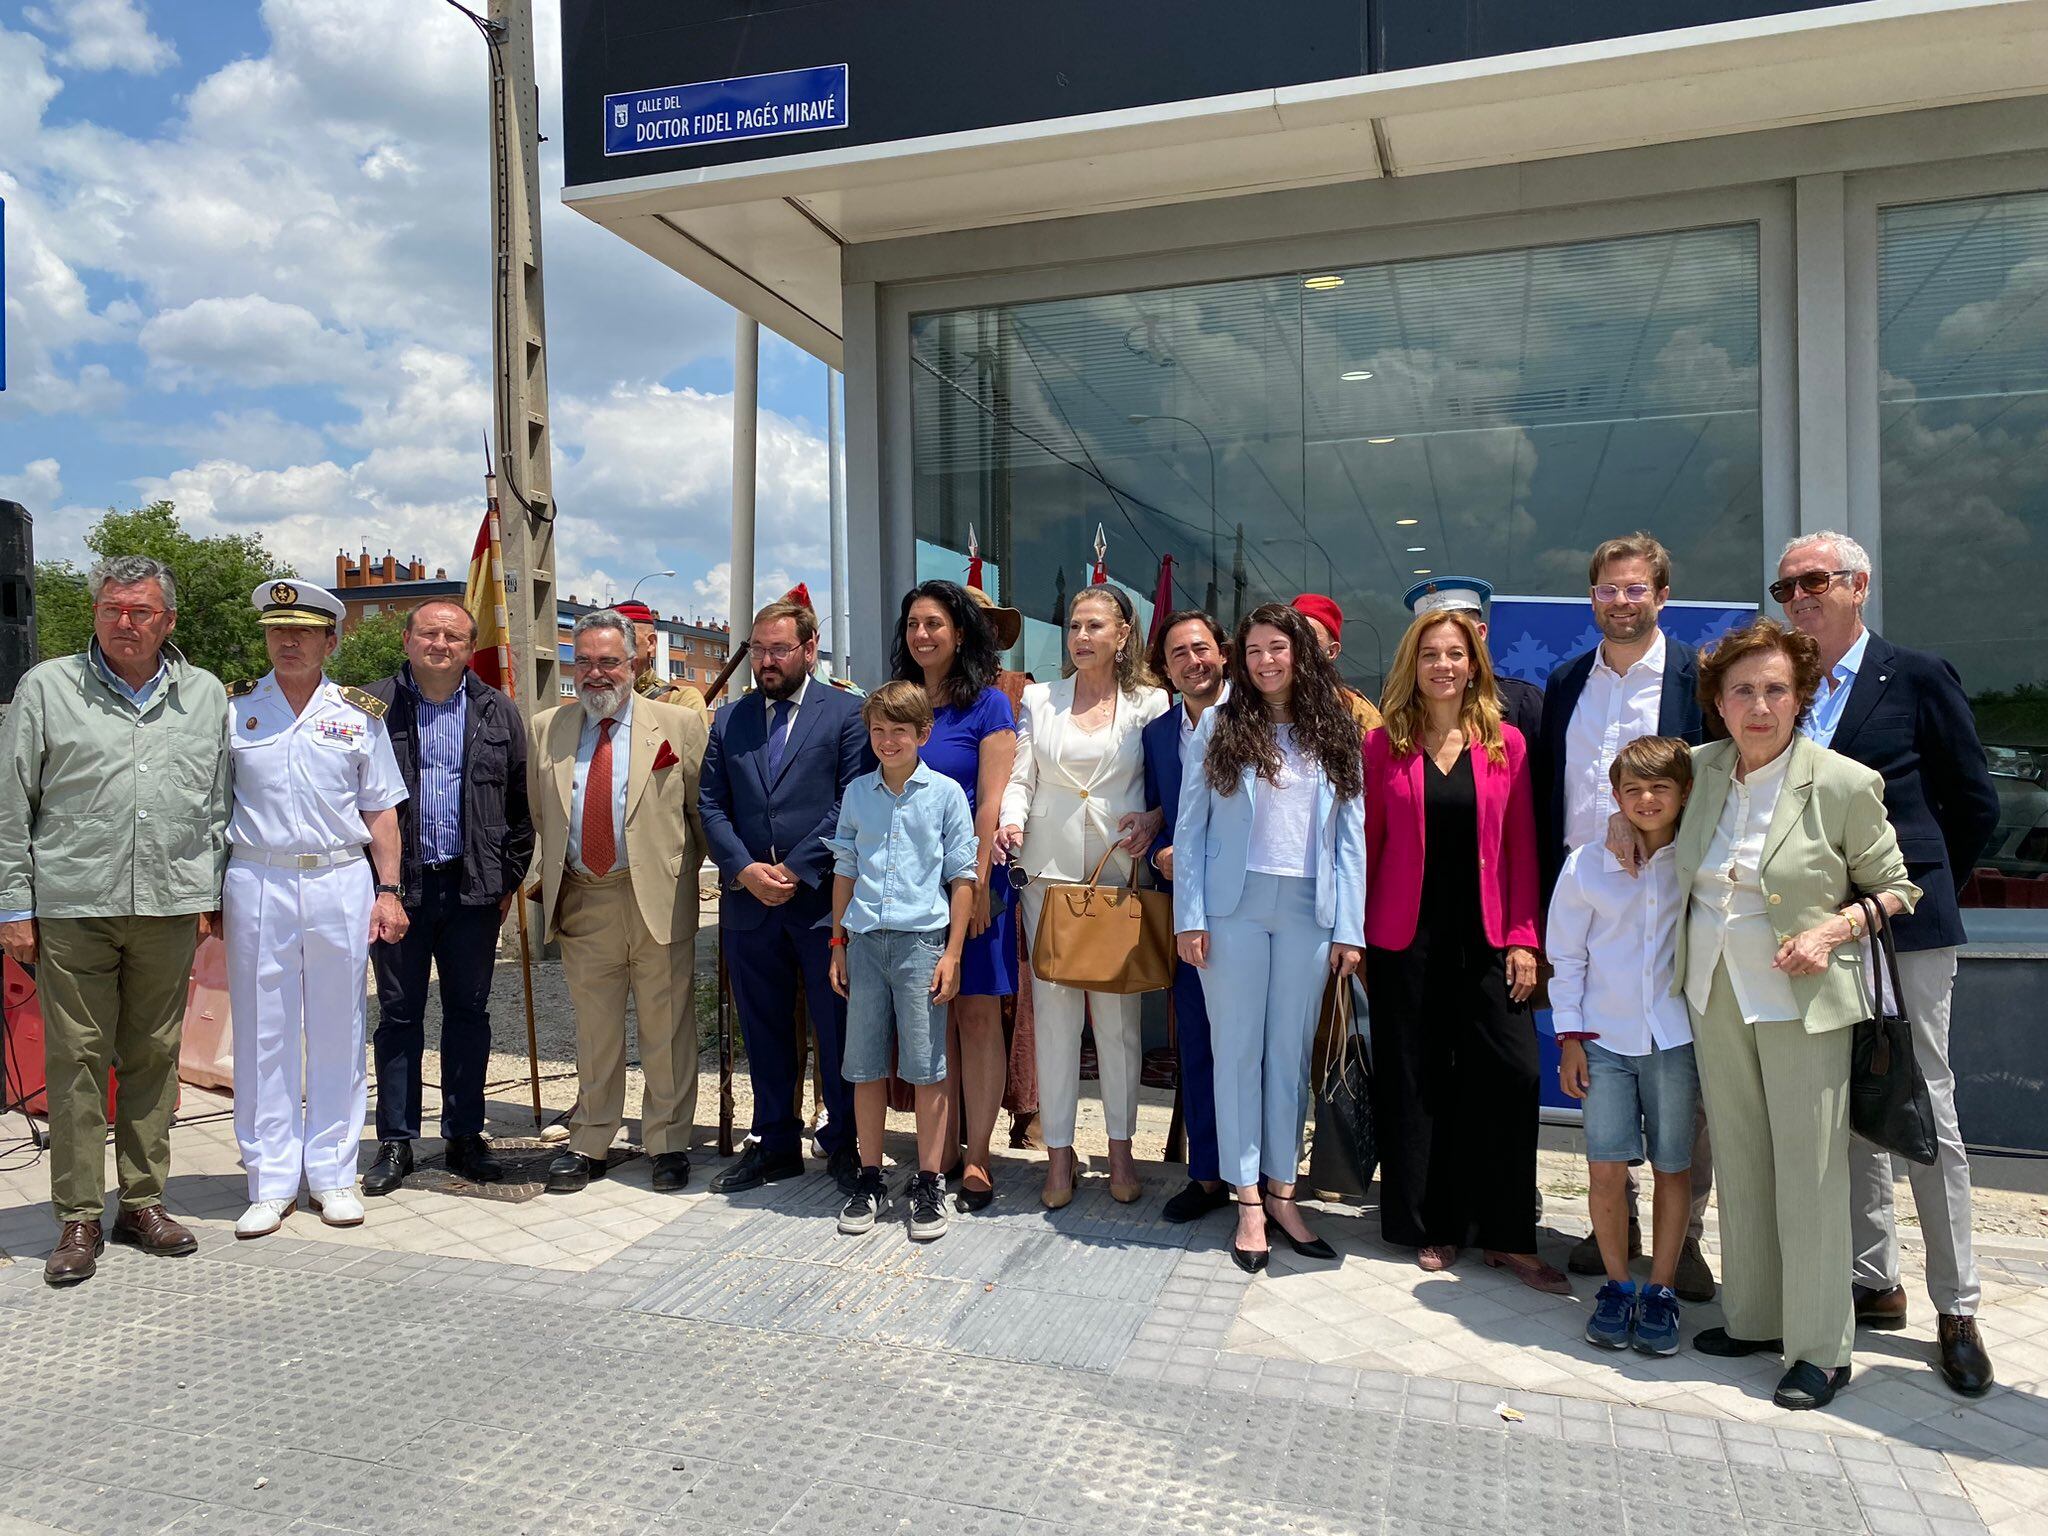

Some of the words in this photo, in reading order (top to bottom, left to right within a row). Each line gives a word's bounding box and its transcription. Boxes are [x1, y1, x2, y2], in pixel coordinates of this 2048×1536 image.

[636, 98, 662, 114] CALLE
[664, 95, 682, 110] DEL
[636, 118, 690, 143] DOCTOR
[694, 112, 732, 135] FIDEL
[736, 102, 779, 130] PAGÉS
[783, 93, 835, 124] MIRAVÉ
